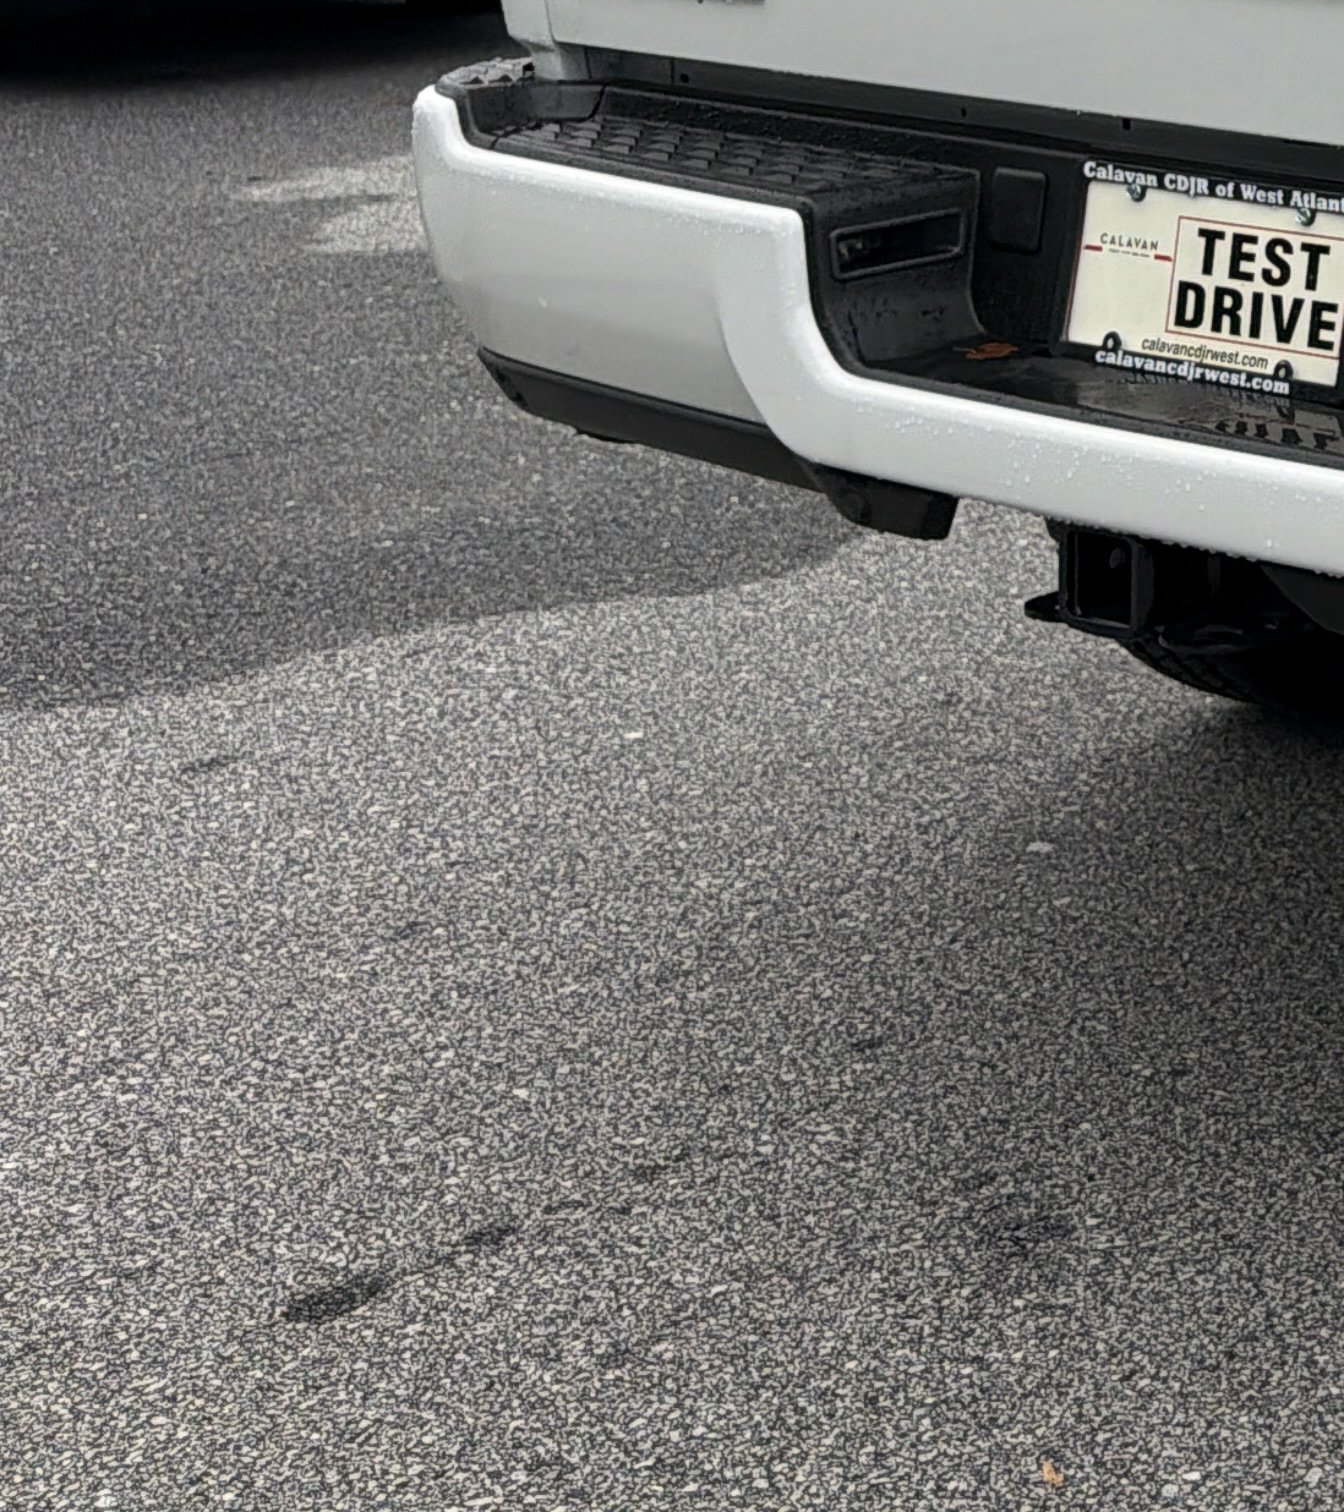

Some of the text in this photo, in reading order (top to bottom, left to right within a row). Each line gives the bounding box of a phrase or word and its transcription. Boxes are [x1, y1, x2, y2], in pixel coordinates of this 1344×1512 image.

[1083, 160, 1158, 188] Calavan
[1163, 173, 1209, 196] CDJR
[1215, 182, 1235, 198] of
[1240, 183, 1284, 206] West
[1100, 232, 1159, 252] CALAVAN
[1197, 226, 1331, 292] TEST
[1173, 280, 1339, 352] DRIVE
[1094, 350, 1291, 396] calavancdjrwest.com
[1141, 336, 1269, 371] calavancdjrwest.com
